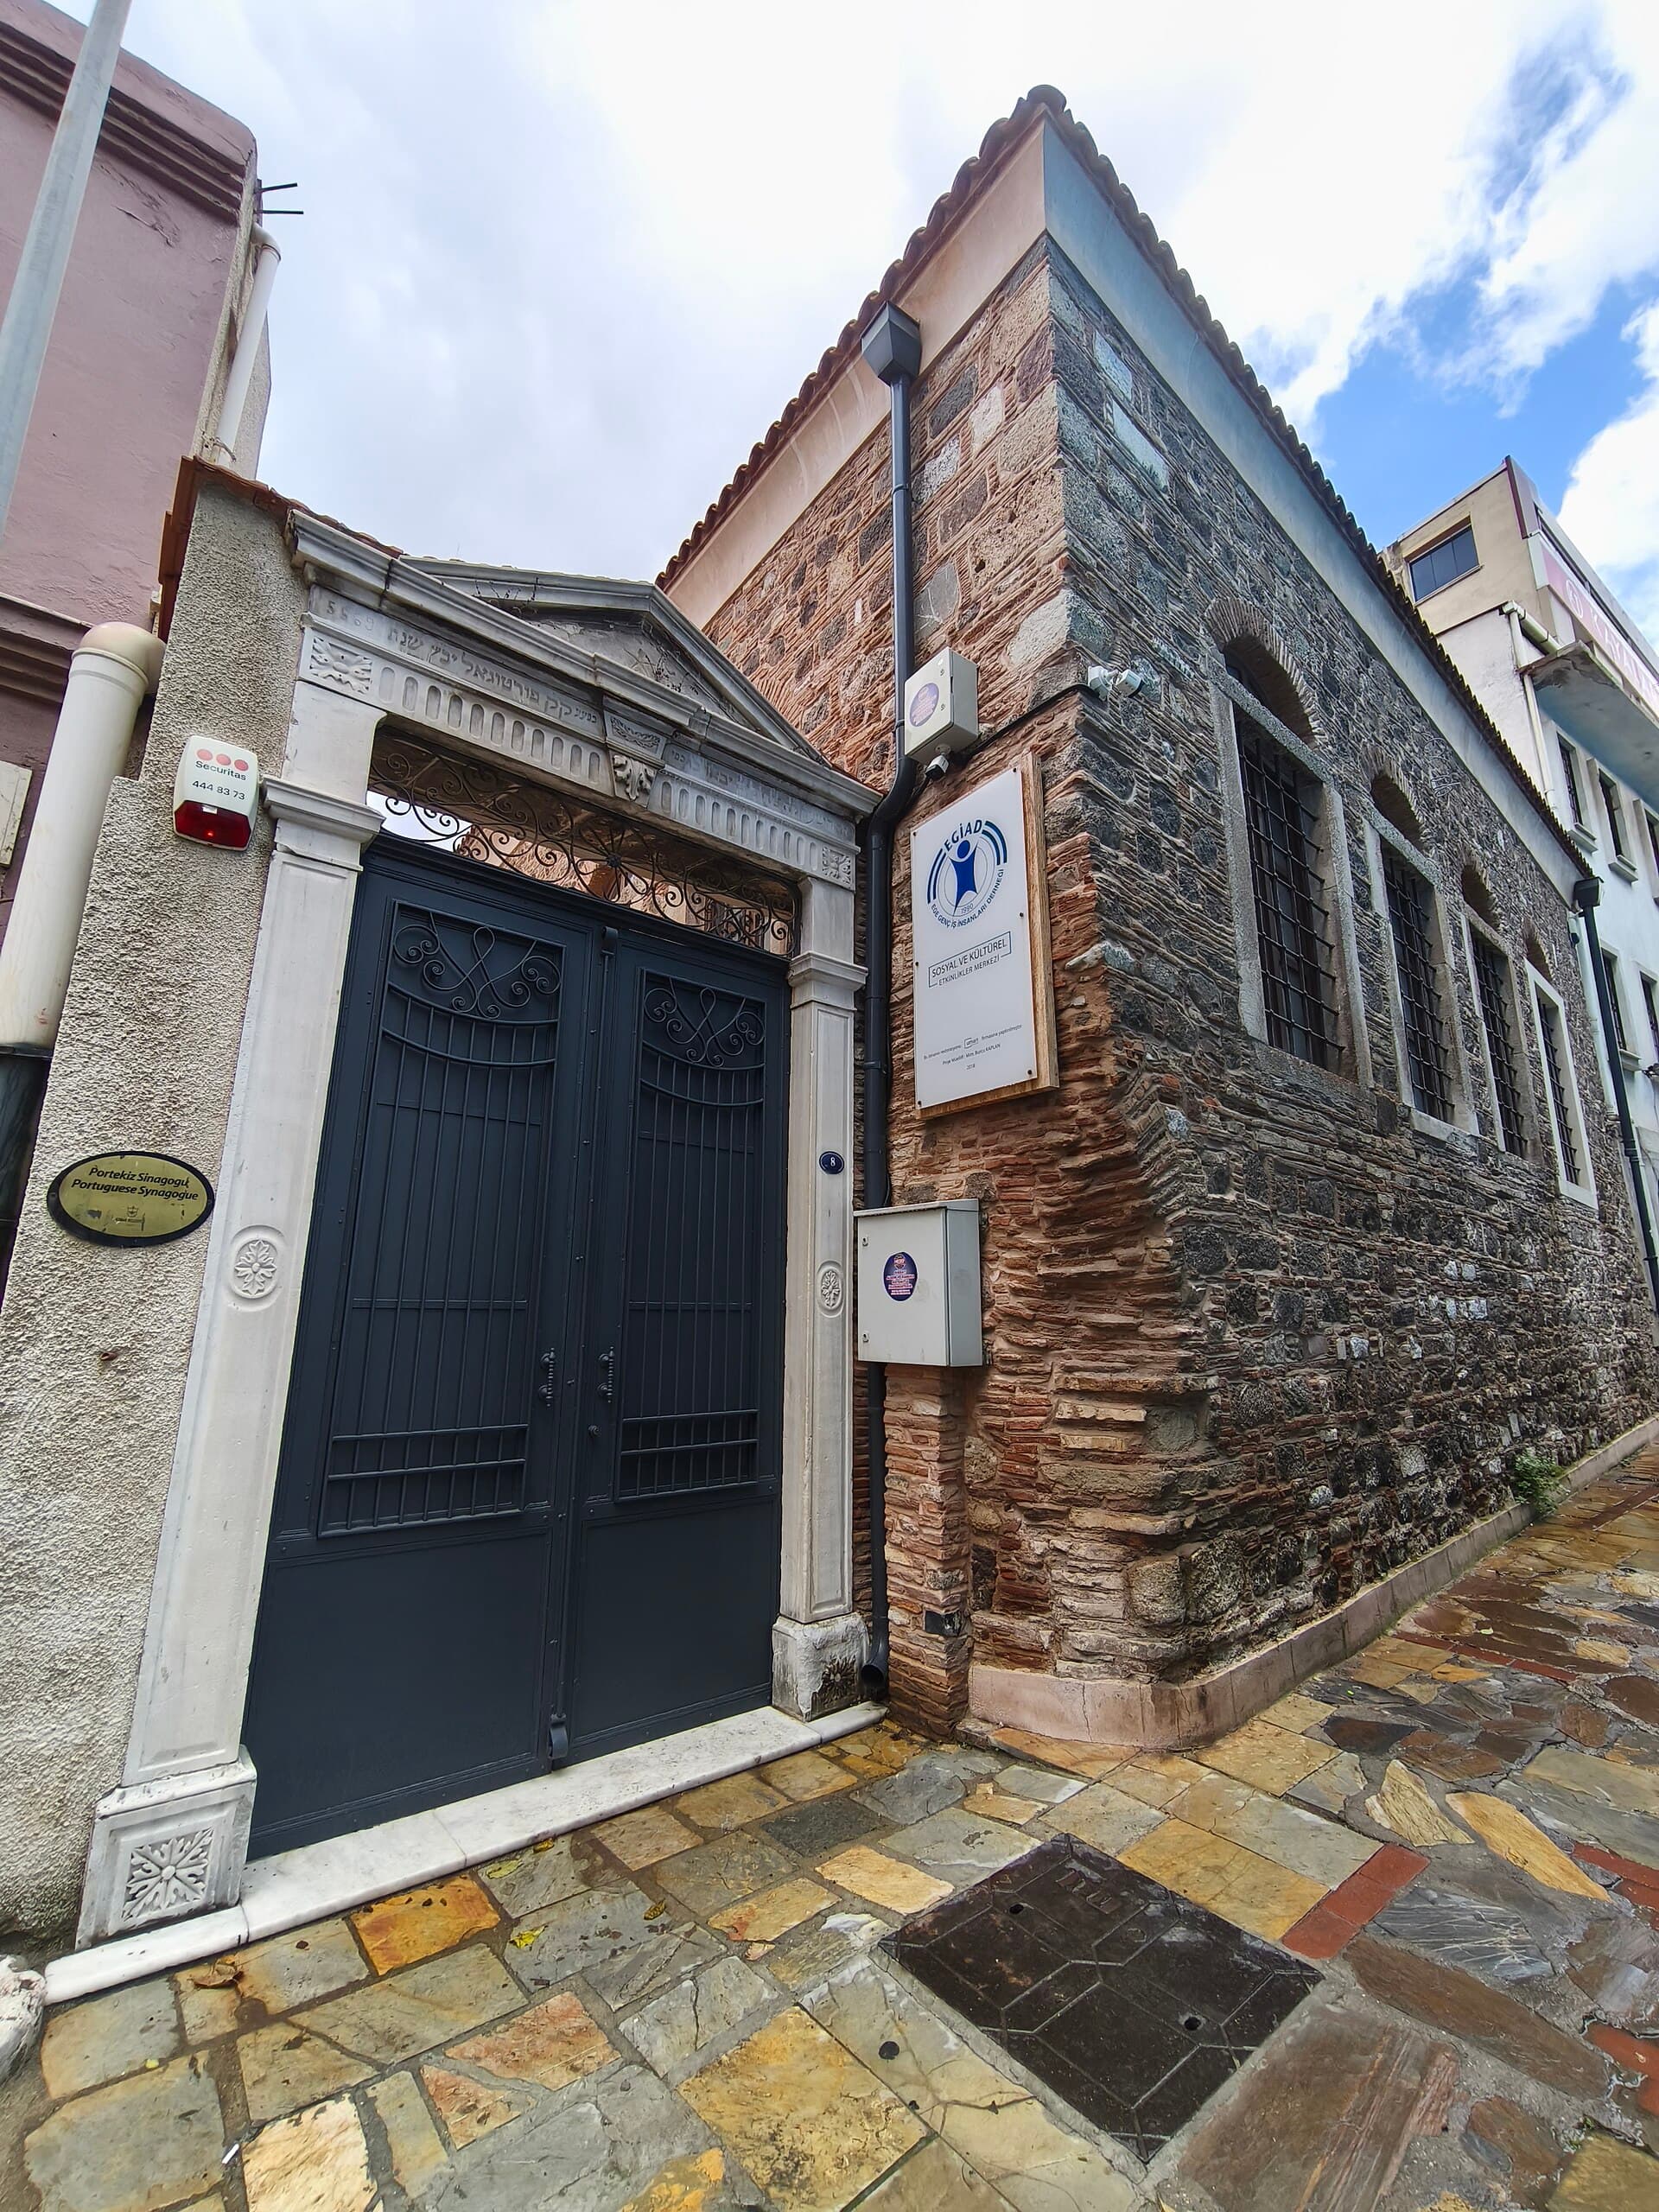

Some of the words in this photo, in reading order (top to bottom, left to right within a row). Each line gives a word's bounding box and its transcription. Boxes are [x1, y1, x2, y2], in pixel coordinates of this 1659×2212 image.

[195, 760, 246, 781] Securitas
[192, 780, 213, 791] 444
[216, 786, 230, 796] 83
[232, 791, 245, 800] 73
[944, 819, 982, 851] EGİAD
[931, 904, 939, 918] EGE
[931, 960, 958, 978] SOSYAL
[958, 956, 968, 966] VE
[969, 938, 1007, 962] KÜLTÜREL
[938, 966, 973, 986] ETKİNLİKLER
[830, 1156, 836, 1166] 8
[88, 1167, 136, 1181] Portekiz
[137, 1173, 188, 1189] Sinagogu
[71, 1179, 137, 1194] Portuguese
[137, 1185, 199, 1201] Synagogue
